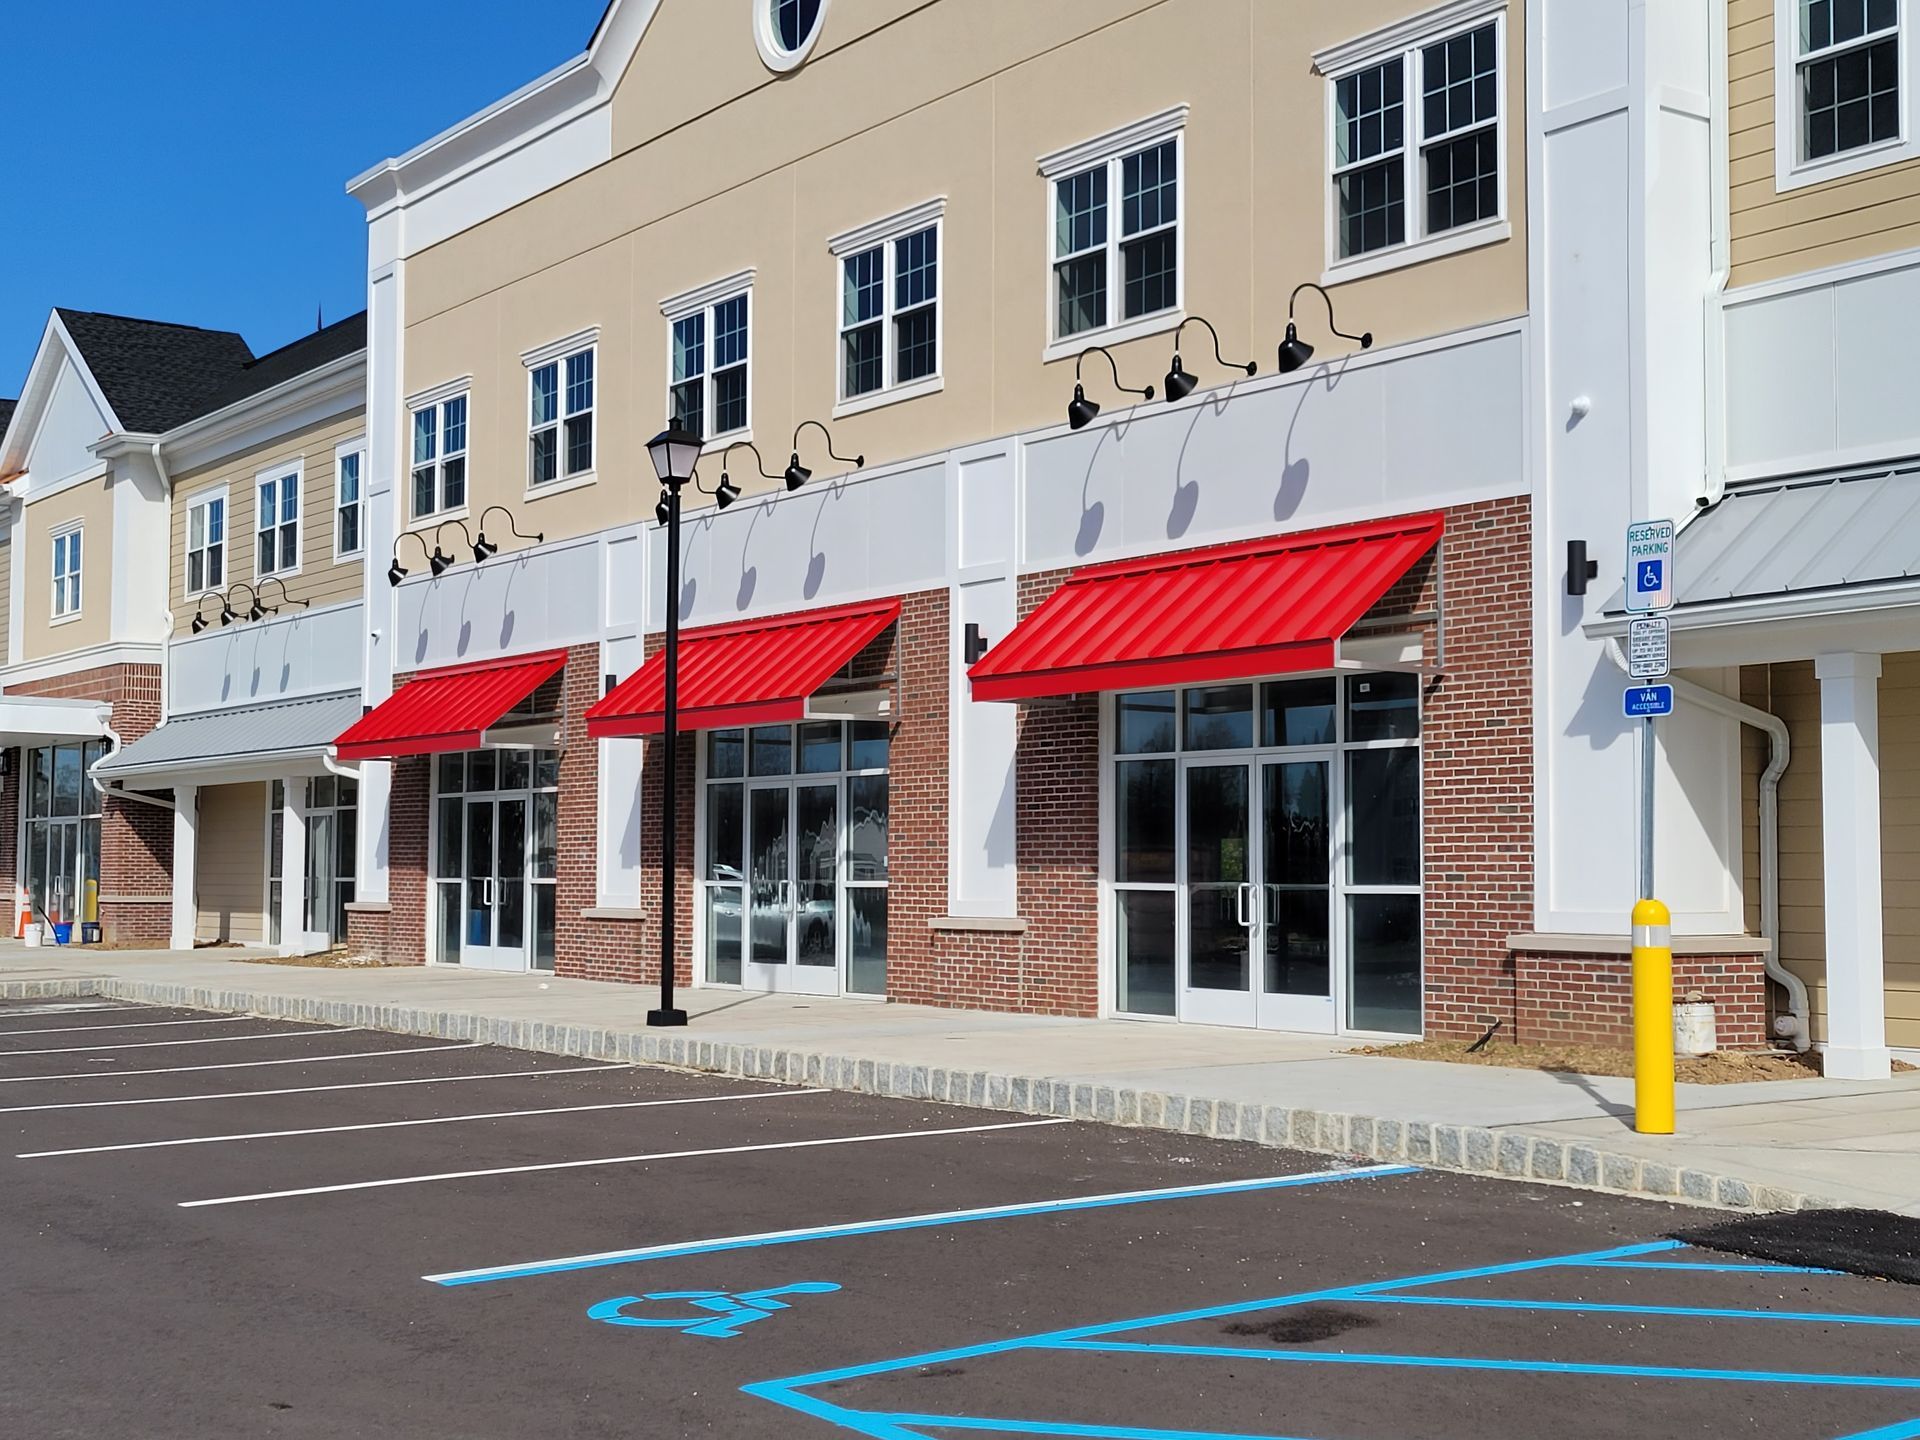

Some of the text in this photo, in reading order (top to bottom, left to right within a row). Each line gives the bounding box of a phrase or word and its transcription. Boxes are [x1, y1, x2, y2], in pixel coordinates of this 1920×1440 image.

[1630, 527, 1670, 542] RESERVED
[1632, 542, 1668, 556] PARKING
[1640, 692, 1657, 702] VAN
[1632, 702, 1664, 710] ACCESSIBLE
